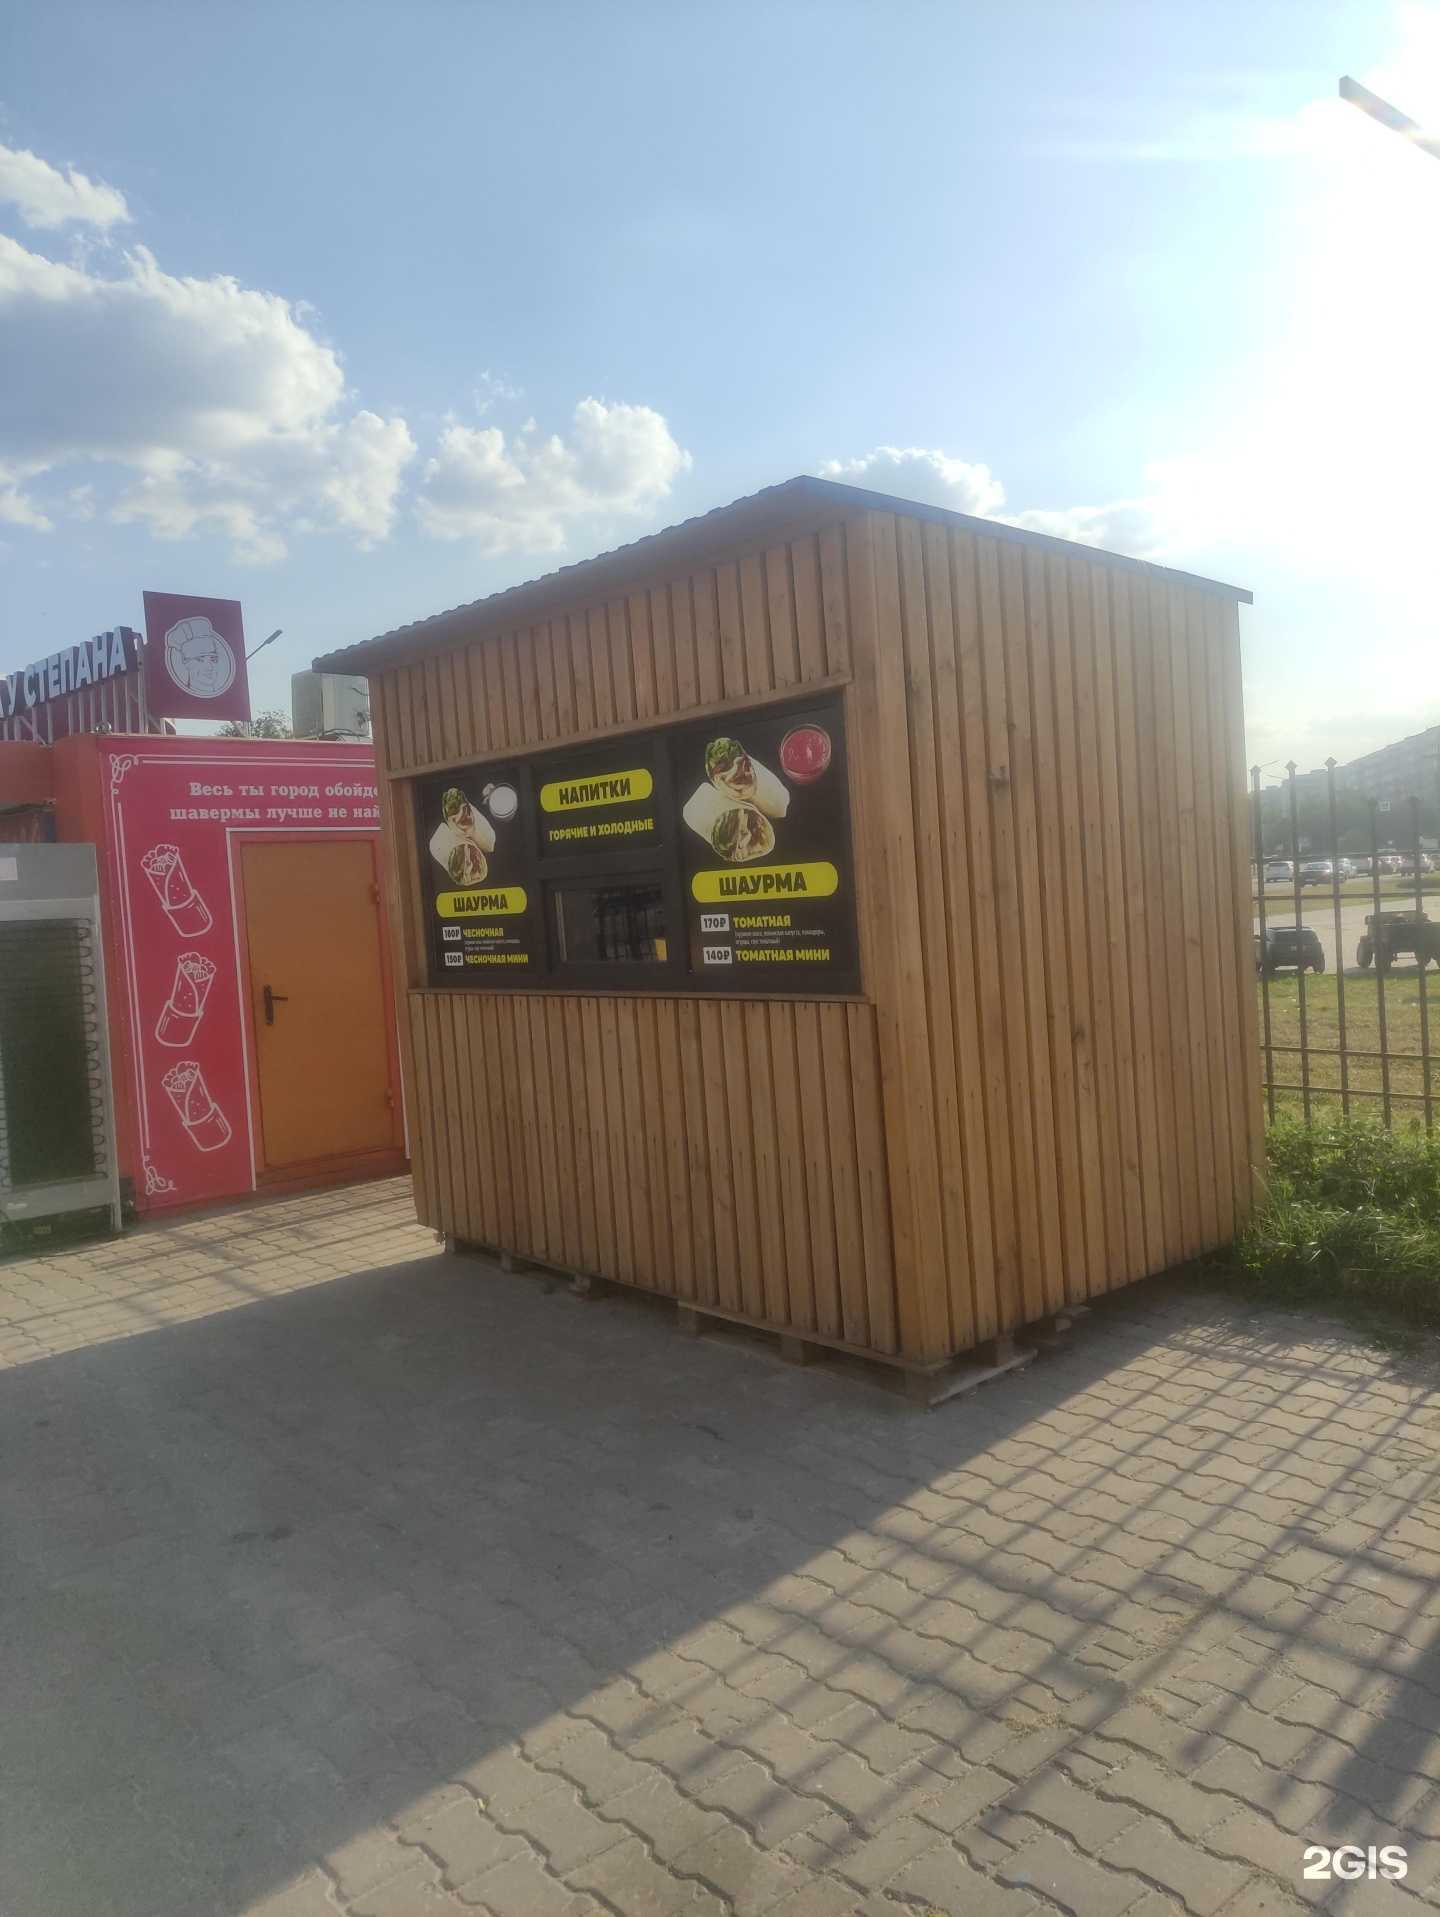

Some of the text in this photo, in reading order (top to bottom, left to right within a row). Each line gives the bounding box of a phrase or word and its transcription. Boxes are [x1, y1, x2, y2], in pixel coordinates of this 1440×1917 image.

[24, 626, 130, 707] СТЕПАНА
[188, 782, 233, 797] Весь
[239, 784, 264, 797] ты
[271, 784, 319, 799] город
[558, 778, 632, 805] НАПИТКИ
[169, 807, 260, 822] шавермы
[266, 806, 322, 822] лучше
[328, 807, 348, 818] не
[549, 818, 654, 841] ГОРЯЧИЕ И ХОЛОДНЫЕ
[719, 871, 808, 896] ШАУРМА
[453, 894, 509, 913] ШАУРМА
[733, 915, 791, 928] ТОМАТНАЯ
[463, 927, 504, 937] ЧЕСНОЧНАЯ
[465, 954, 506, 964] ЧЕСНОЧНАЯ
[507, 953, 529, 964] МИНИ
[736, 949, 794, 961] ТОМАТНАЯ
[796, 949, 830, 961] МИНИ
